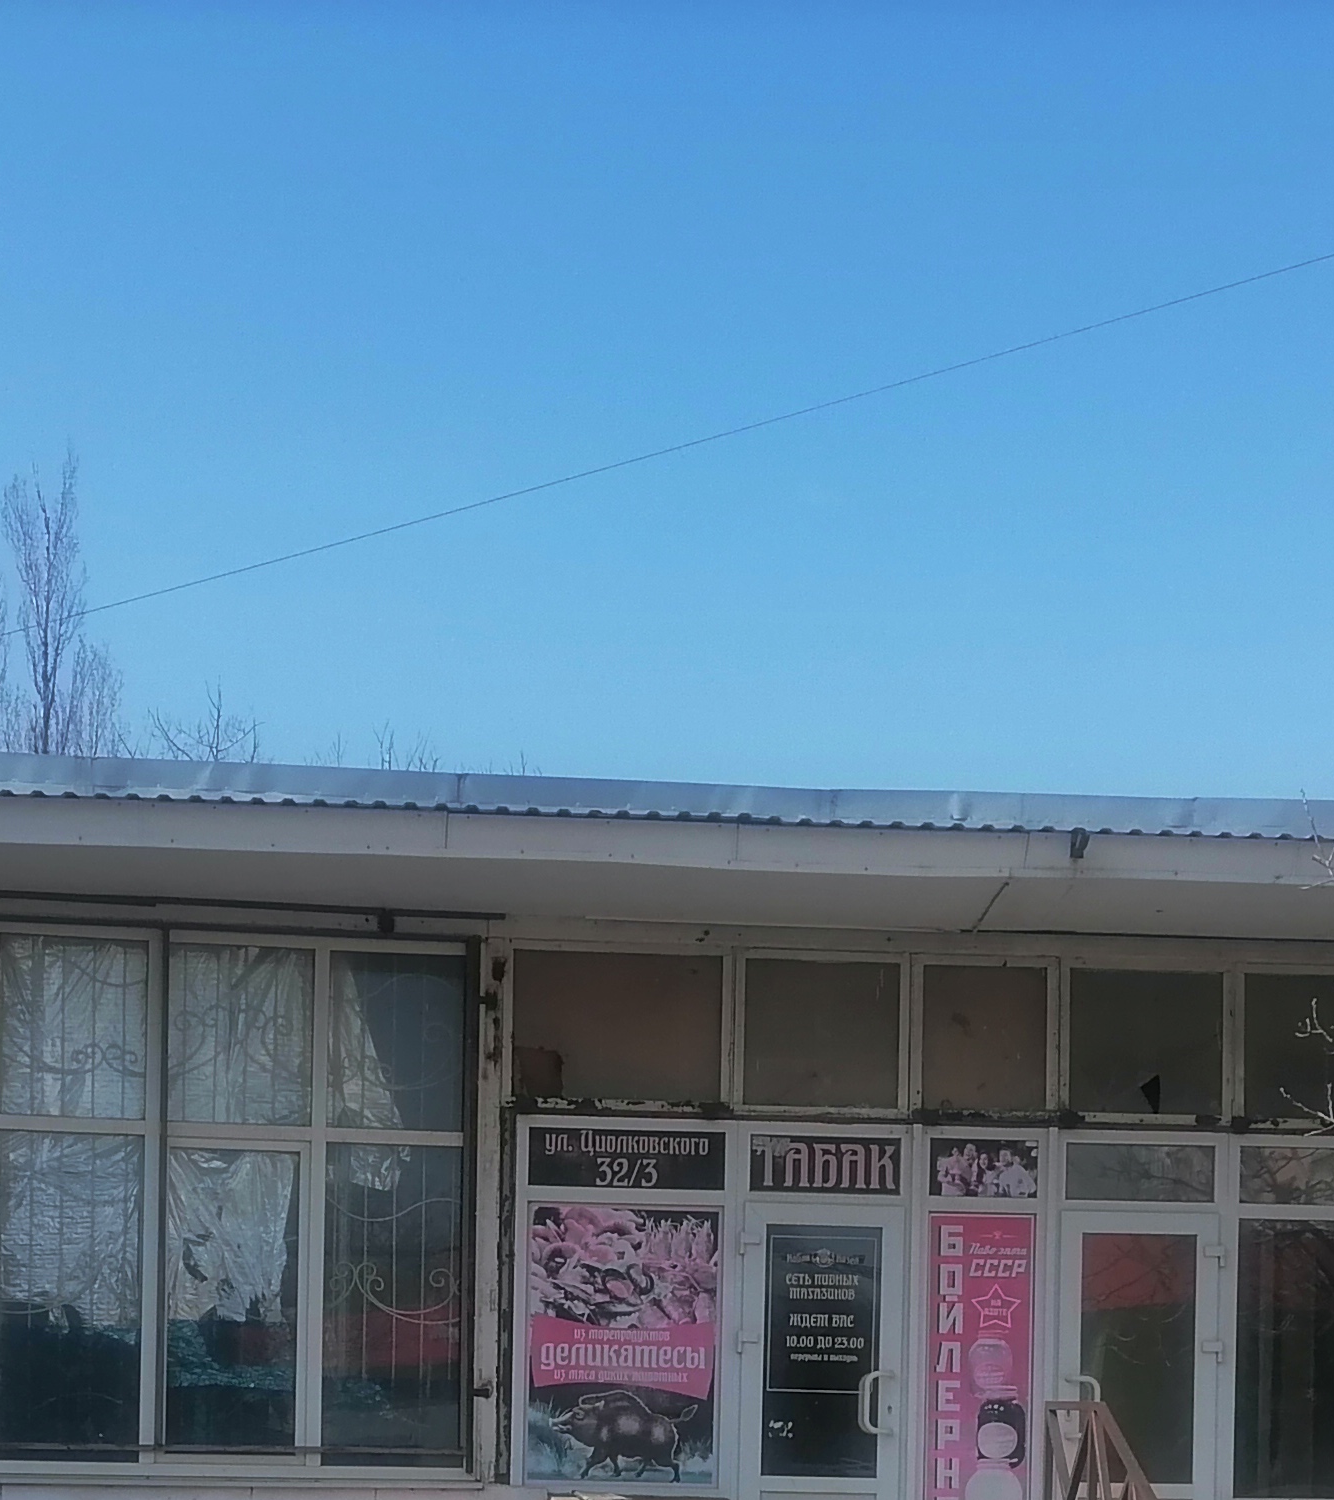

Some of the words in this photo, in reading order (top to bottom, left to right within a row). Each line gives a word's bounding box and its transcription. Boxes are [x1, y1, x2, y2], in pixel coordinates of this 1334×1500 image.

[545, 1133, 573, 1155] ул.
[580, 1130, 709, 1156] Циолковского
[595, 1157, 659, 1187] 32/3
[752, 1137, 896, 1189] ТАБАК
[969, 1259, 1027, 1277] СССР
[785, 1273, 812, 1285] СЕТЬ
[814, 1274, 859, 1286] ПИВНЫХ
[789, 1313, 829, 1328] ЖДЕМ
[832, 1314, 854, 1327] ВАС
[786, 1335, 814, 1347] 10.00
[816, 1336, 832, 1349] ДО
[834, 1337, 864, 1349] 23.00
[540, 1342, 706, 1370] деликатесы
